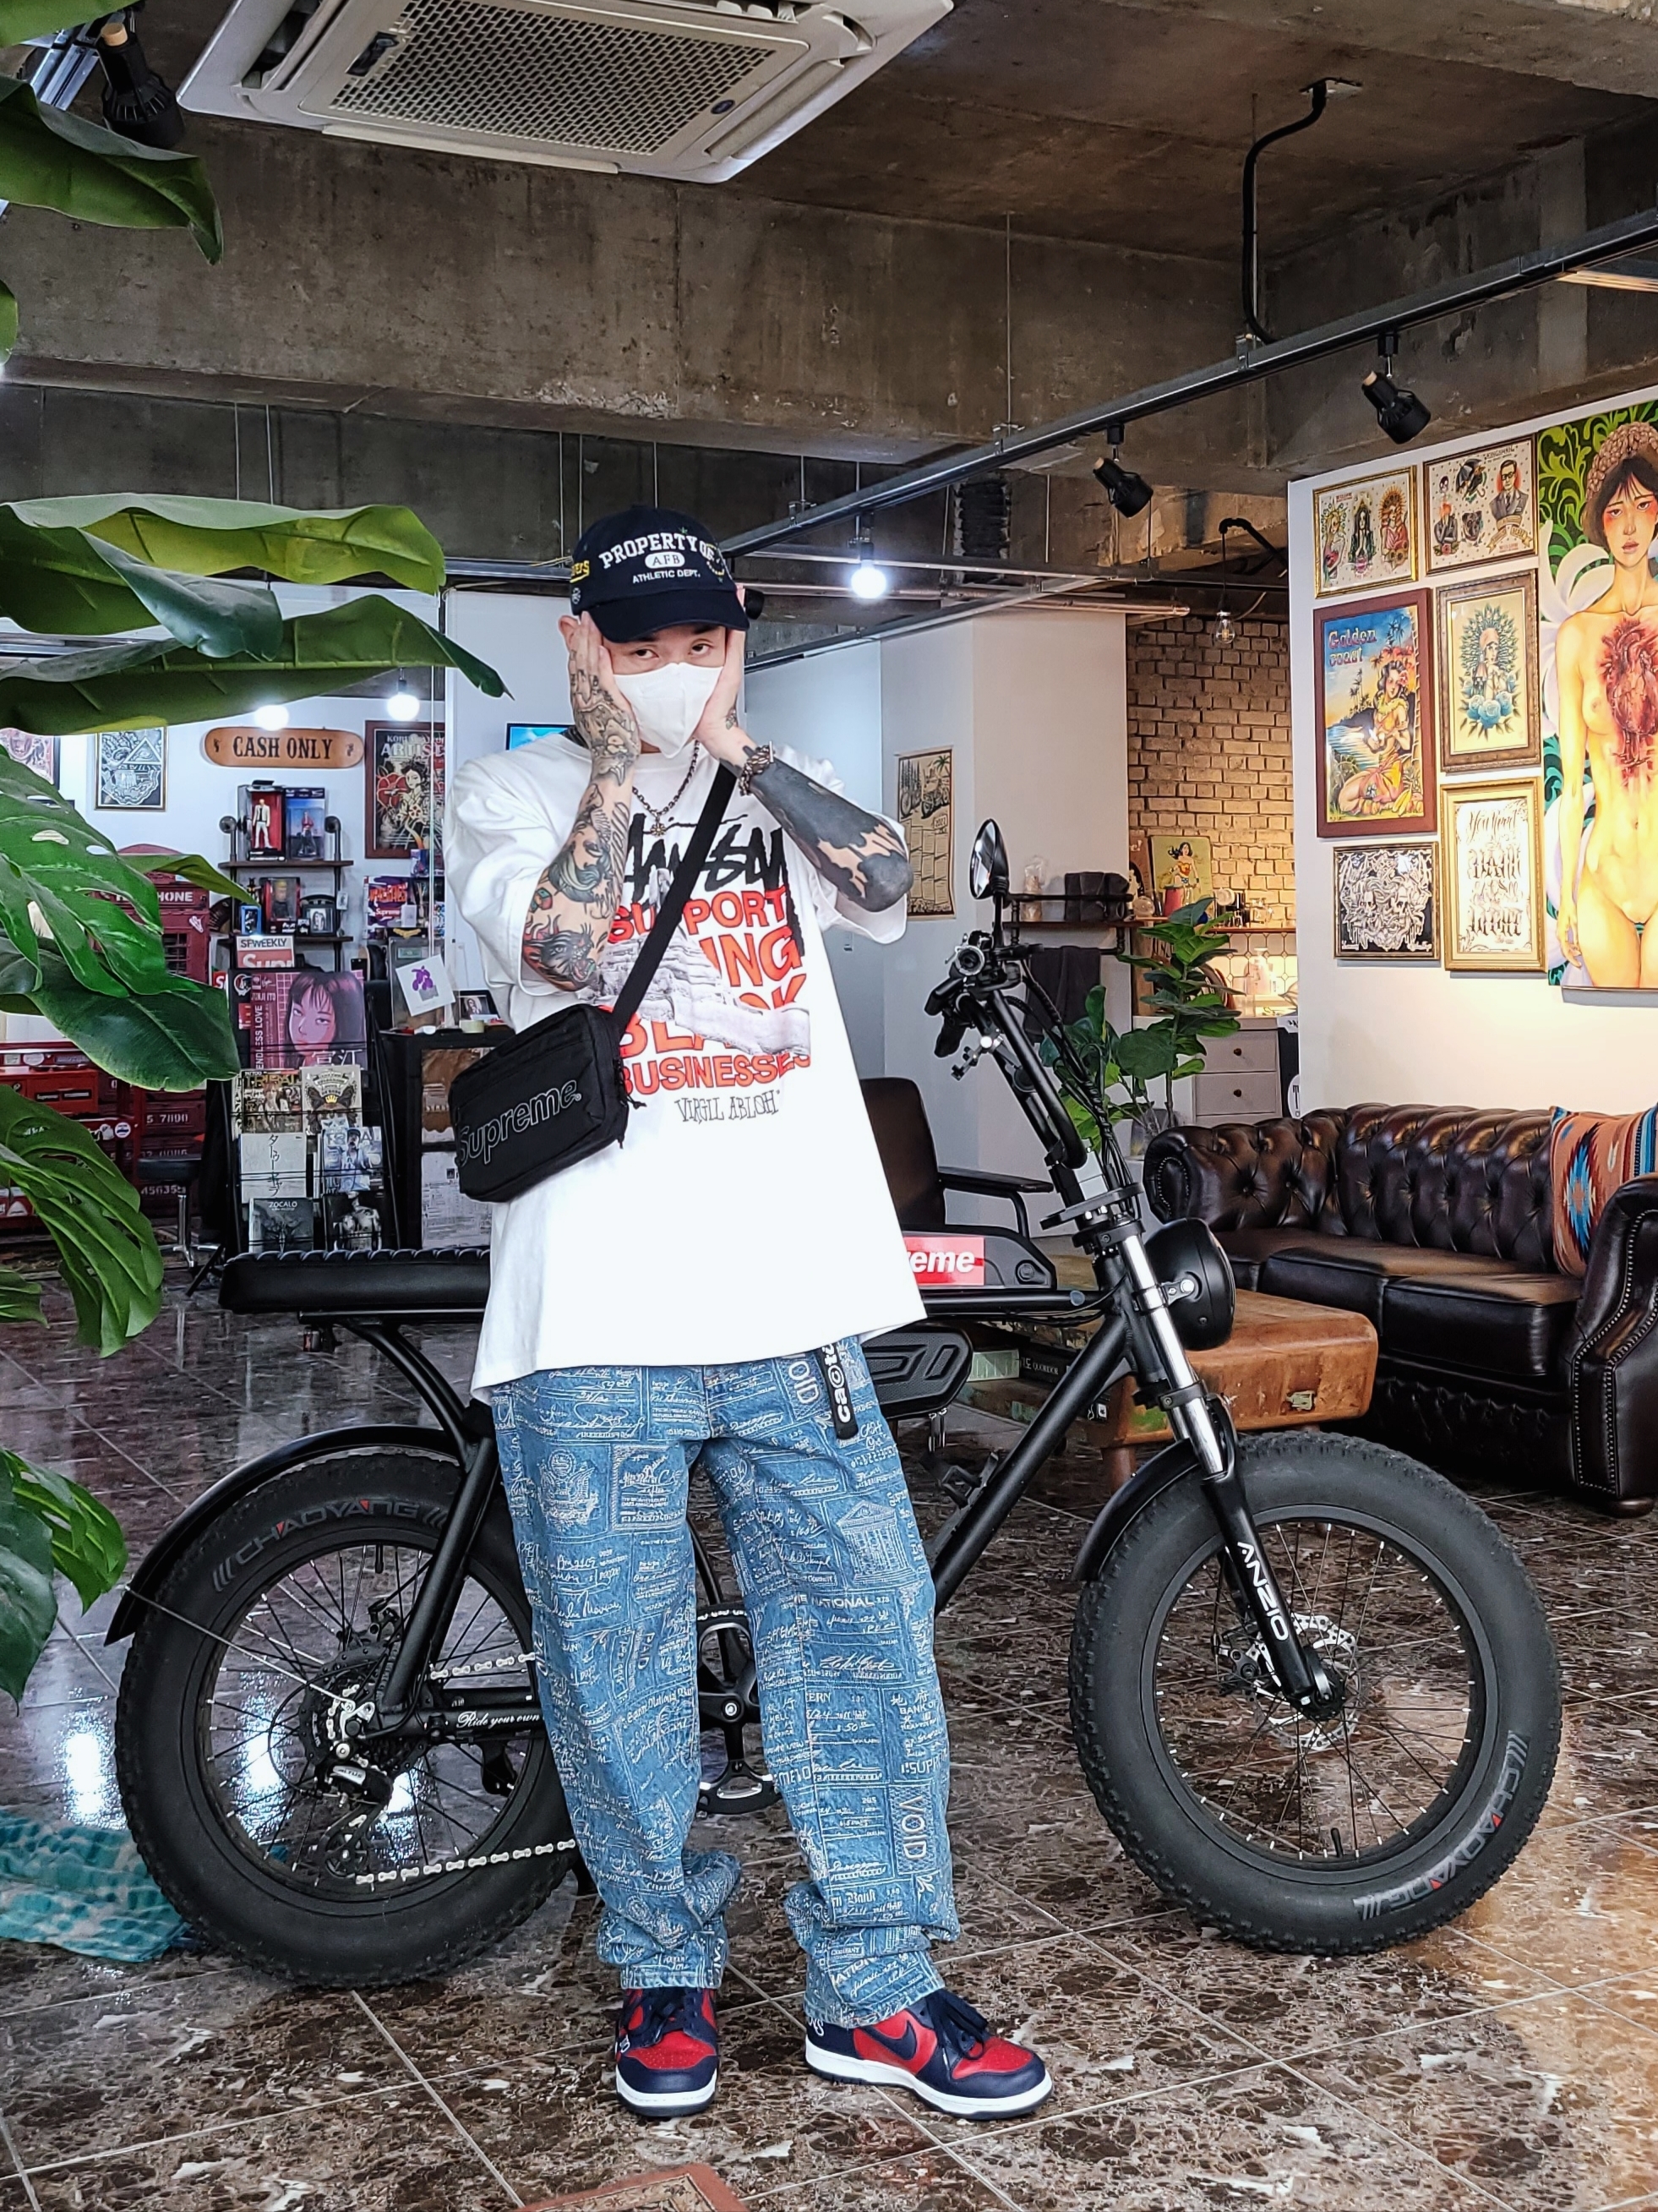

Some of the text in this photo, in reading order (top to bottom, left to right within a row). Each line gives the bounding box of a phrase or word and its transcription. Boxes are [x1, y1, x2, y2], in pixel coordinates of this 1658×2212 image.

[598, 532, 699, 570] PROPERTY
[652, 555, 680, 567] AFB
[632, 570, 675, 584] ATHLETIC
[1328, 627, 1377, 649] Golden
[232, 735, 333, 760] CASH ONLY
[608, 886, 787, 943] SUPORT
[254, 1004, 265, 1070] ENDLESS LOVE
[268, 1200, 298, 1209] ZOCALO
[907, 1250, 975, 1274] eme
[234, 1499, 421, 1565] CHAOYANG
[1236, 1541, 1290, 1641] ANZIO
[456, 1710, 541, 1729] Ride your own
[897, 1795, 928, 1860] VOID
